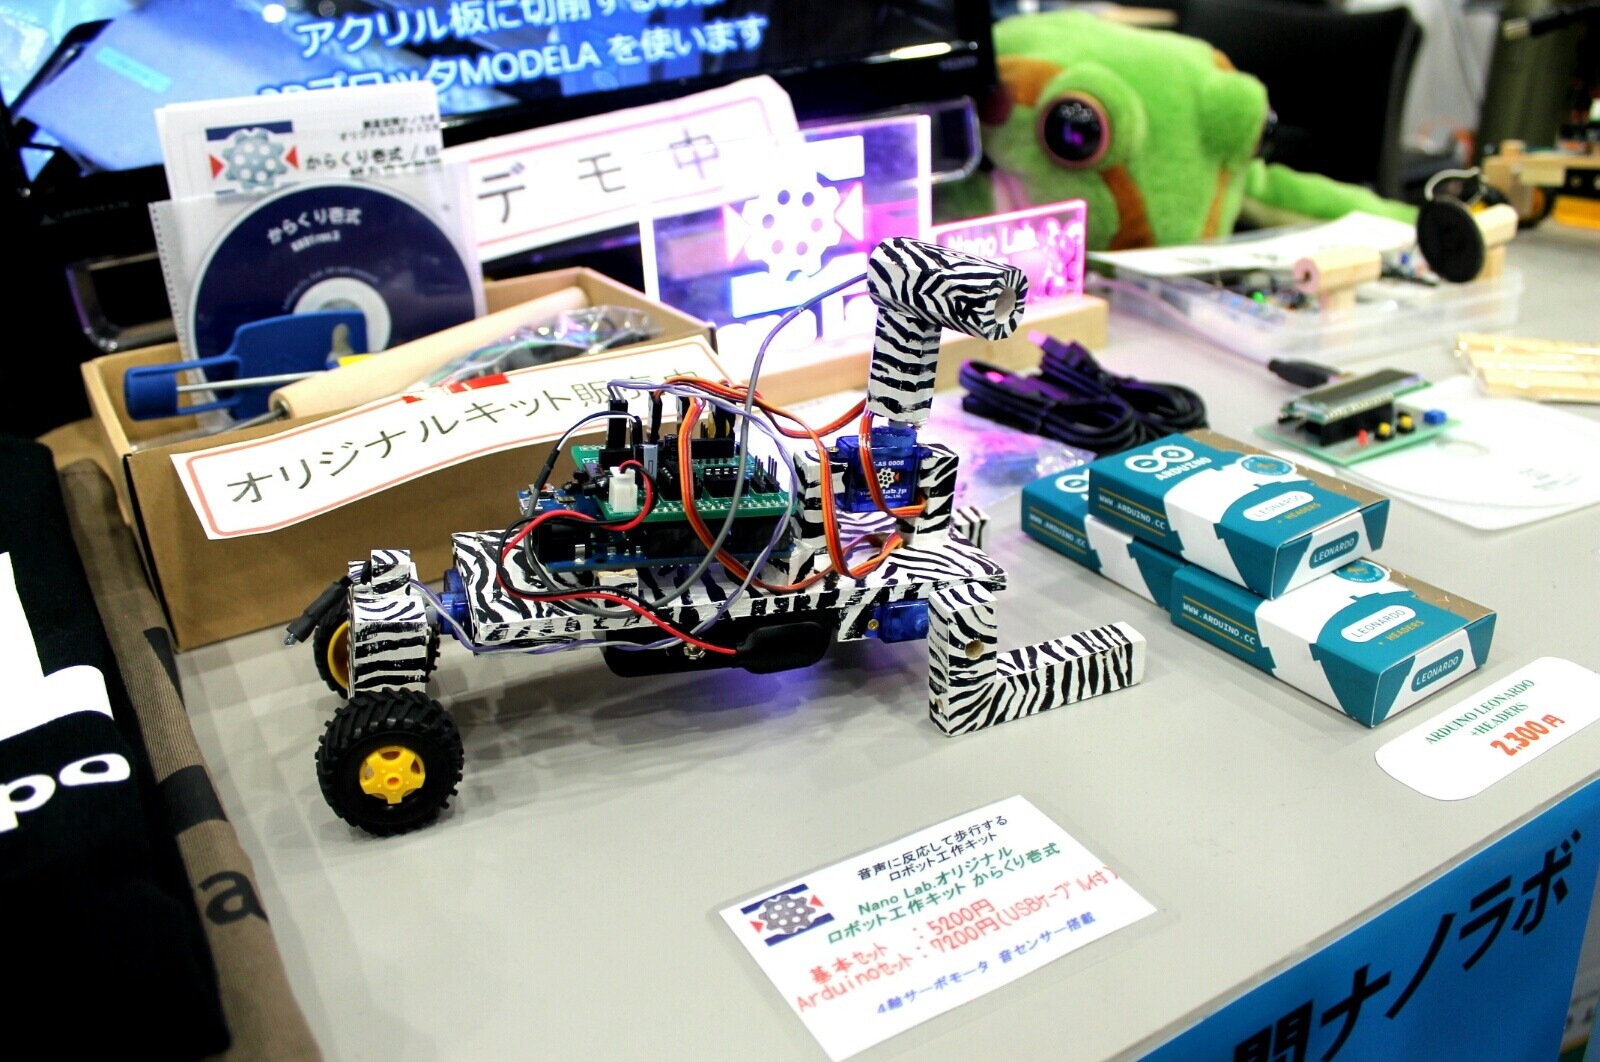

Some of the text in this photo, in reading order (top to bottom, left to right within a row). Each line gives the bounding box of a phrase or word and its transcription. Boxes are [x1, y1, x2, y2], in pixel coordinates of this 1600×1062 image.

[226, 369, 698, 504] オリジナルキット販
[1155, 456, 1213, 481] ARDUINO
[1313, 537, 1355, 563] LEONARDO
[1182, 602, 1256, 645] WWW.ARDUINO.CC
[1351, 608, 1406, 638] LEONARDO
[1385, 619, 1425, 641] HEADERS
[1416, 655, 1460, 686] LEONARDO
[1424, 679, 1535, 745] ARDUINO LEONARDO
[1471, 701, 1529, 737] +HEADERS
[857, 815, 1008, 880] 音声に反応して歩行する
[889, 832, 998, 881] ロボット工作キット
[828, 842, 1061, 944] ロボット工作キット からくり壱式
[858, 894, 899, 915] Nano
